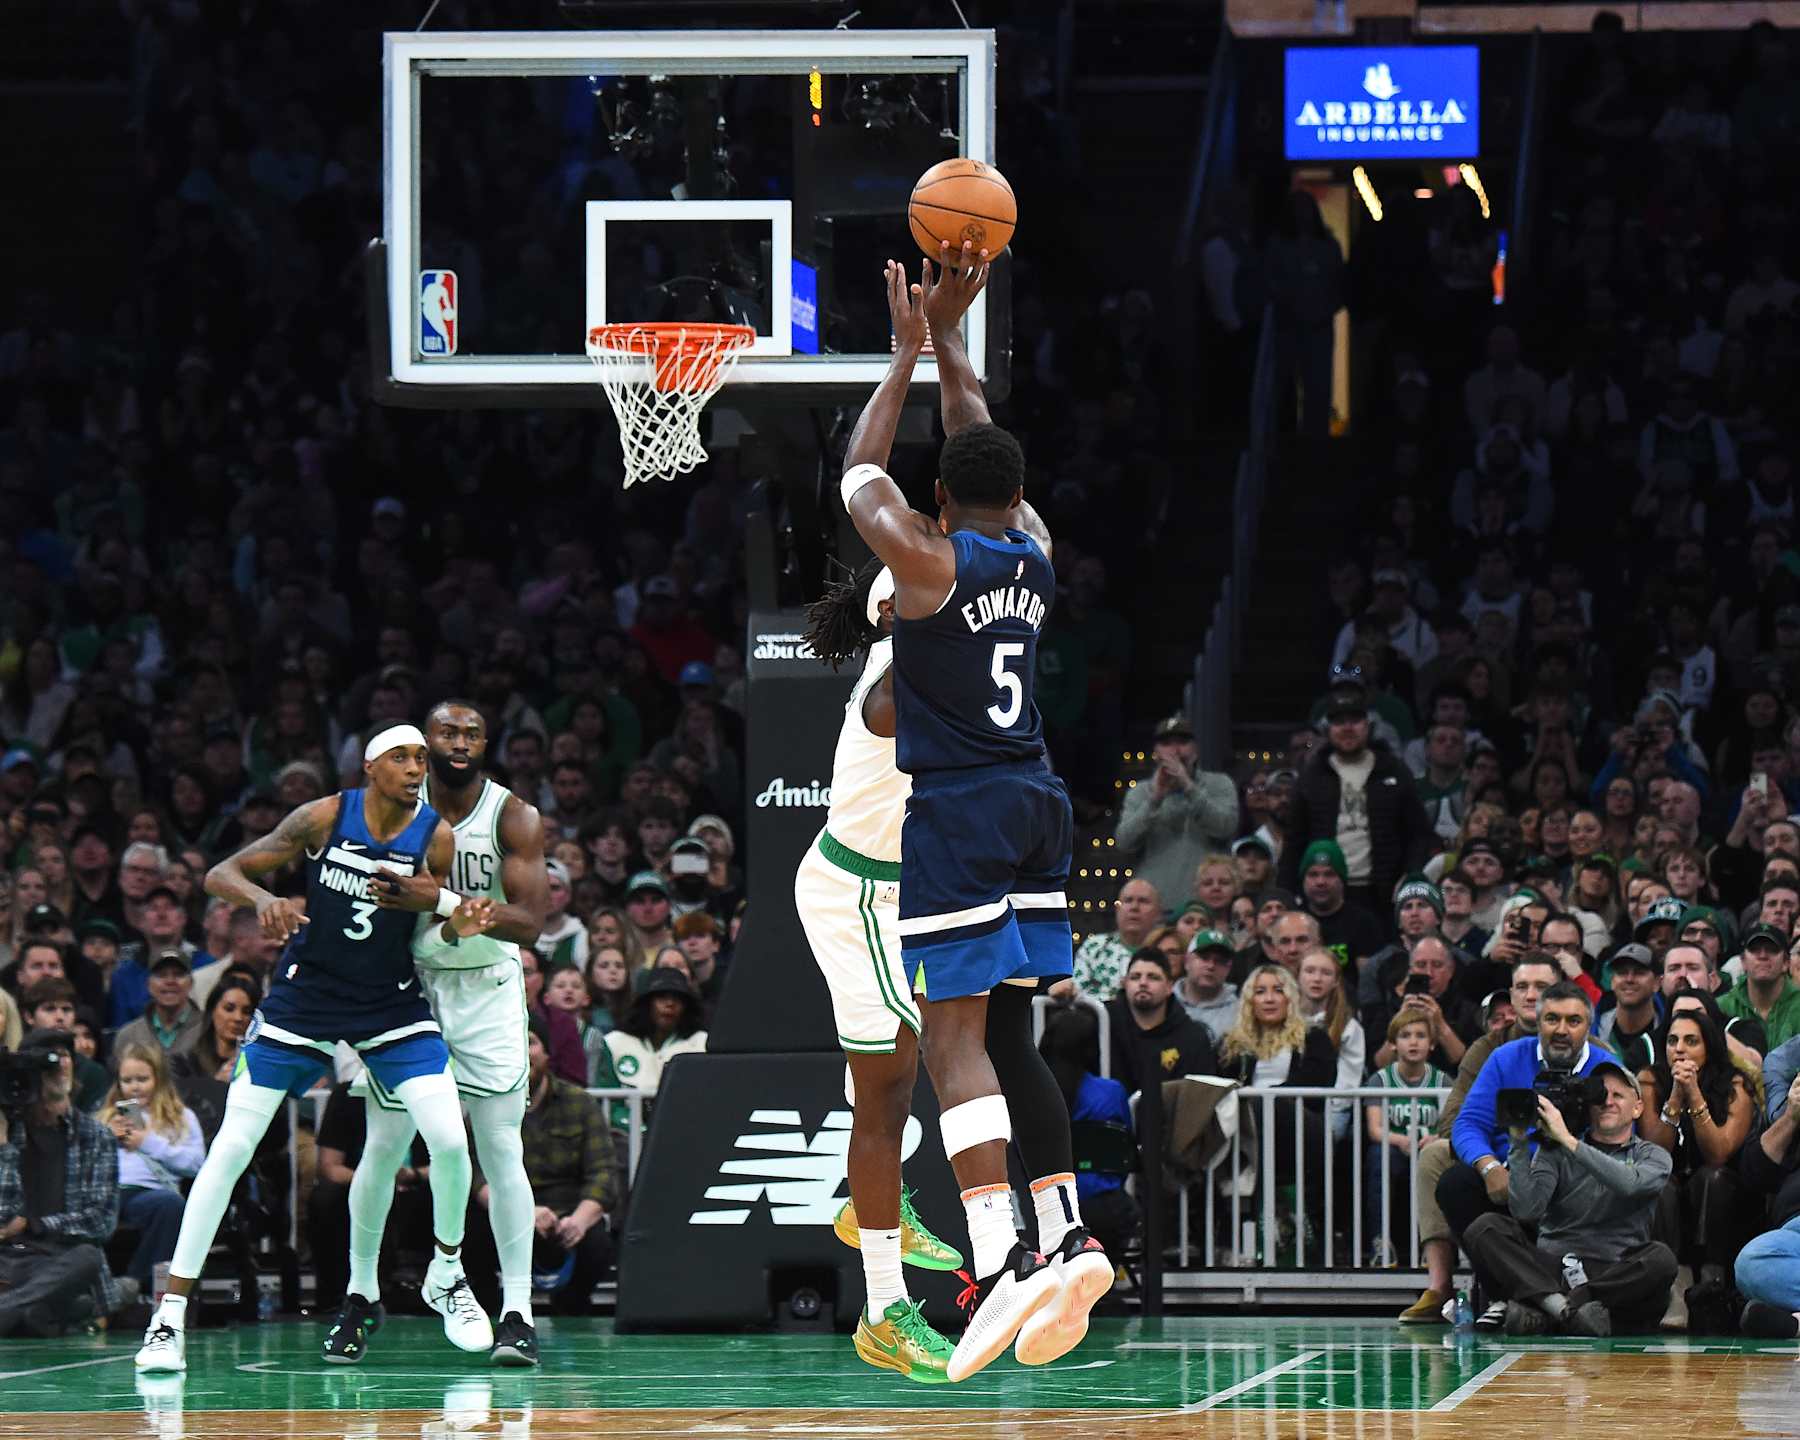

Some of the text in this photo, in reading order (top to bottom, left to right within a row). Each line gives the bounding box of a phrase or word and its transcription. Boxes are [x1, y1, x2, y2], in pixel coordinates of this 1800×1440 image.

[1295, 98, 1467, 126] ARBELLA
[1316, 125, 1444, 142] INSURANCE
[961, 586, 1046, 634] EDWARDS
[753, 640, 794, 660] abu
[987, 643, 1025, 729] 5
[755, 777, 832, 808] Amic
[319, 863, 379, 900] MINNE
[343, 901, 379, 941] 3
